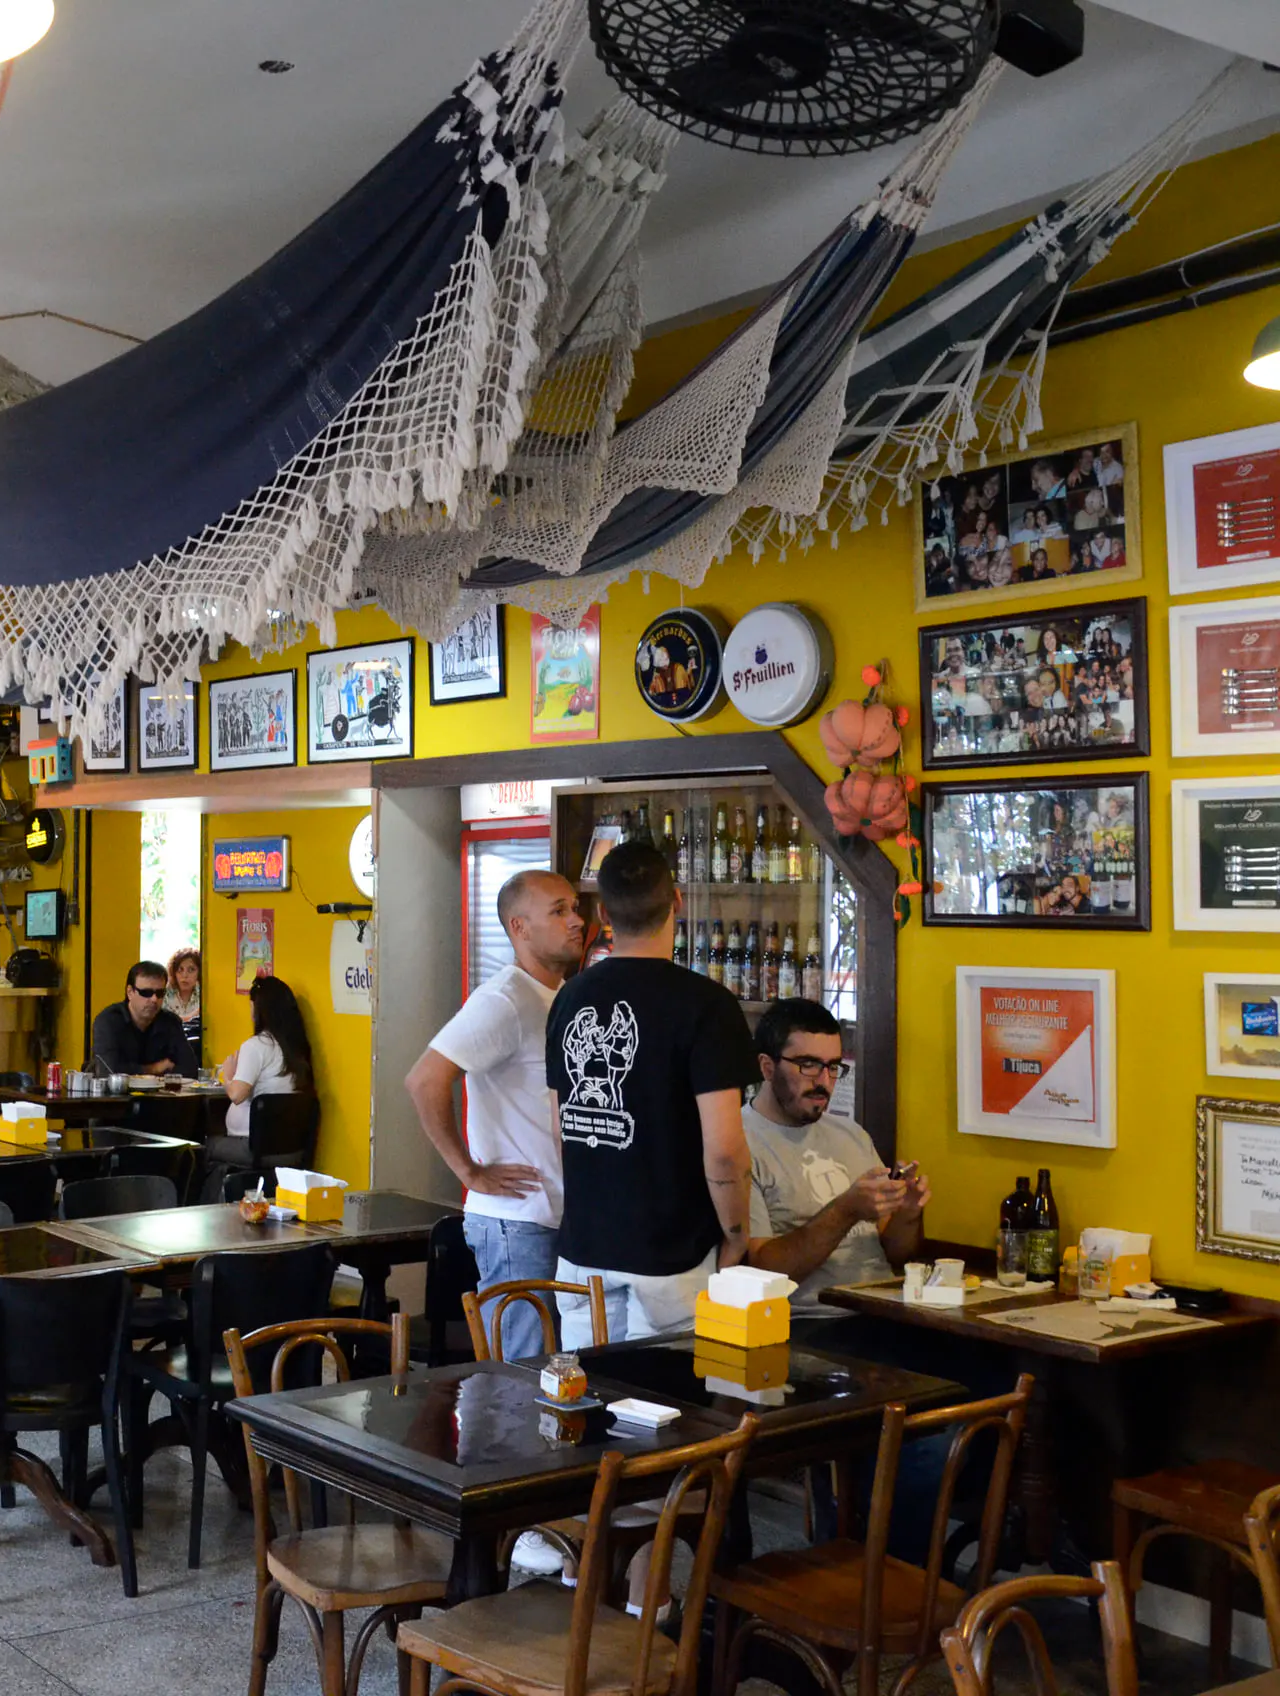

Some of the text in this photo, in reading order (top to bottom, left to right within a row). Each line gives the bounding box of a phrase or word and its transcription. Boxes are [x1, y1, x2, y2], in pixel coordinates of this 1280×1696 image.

[743, 661, 796, 693] Feuillien
[499, 780, 534, 804] DEVASSA
[242, 917, 268, 934] FLORIS
[993, 996, 1060, 1014] VOTAÇÃO ON LINE
[985, 1013, 1069, 1030] MELHOR RESTAURANTE
[1011, 1059, 1041, 1075] Tijuca
